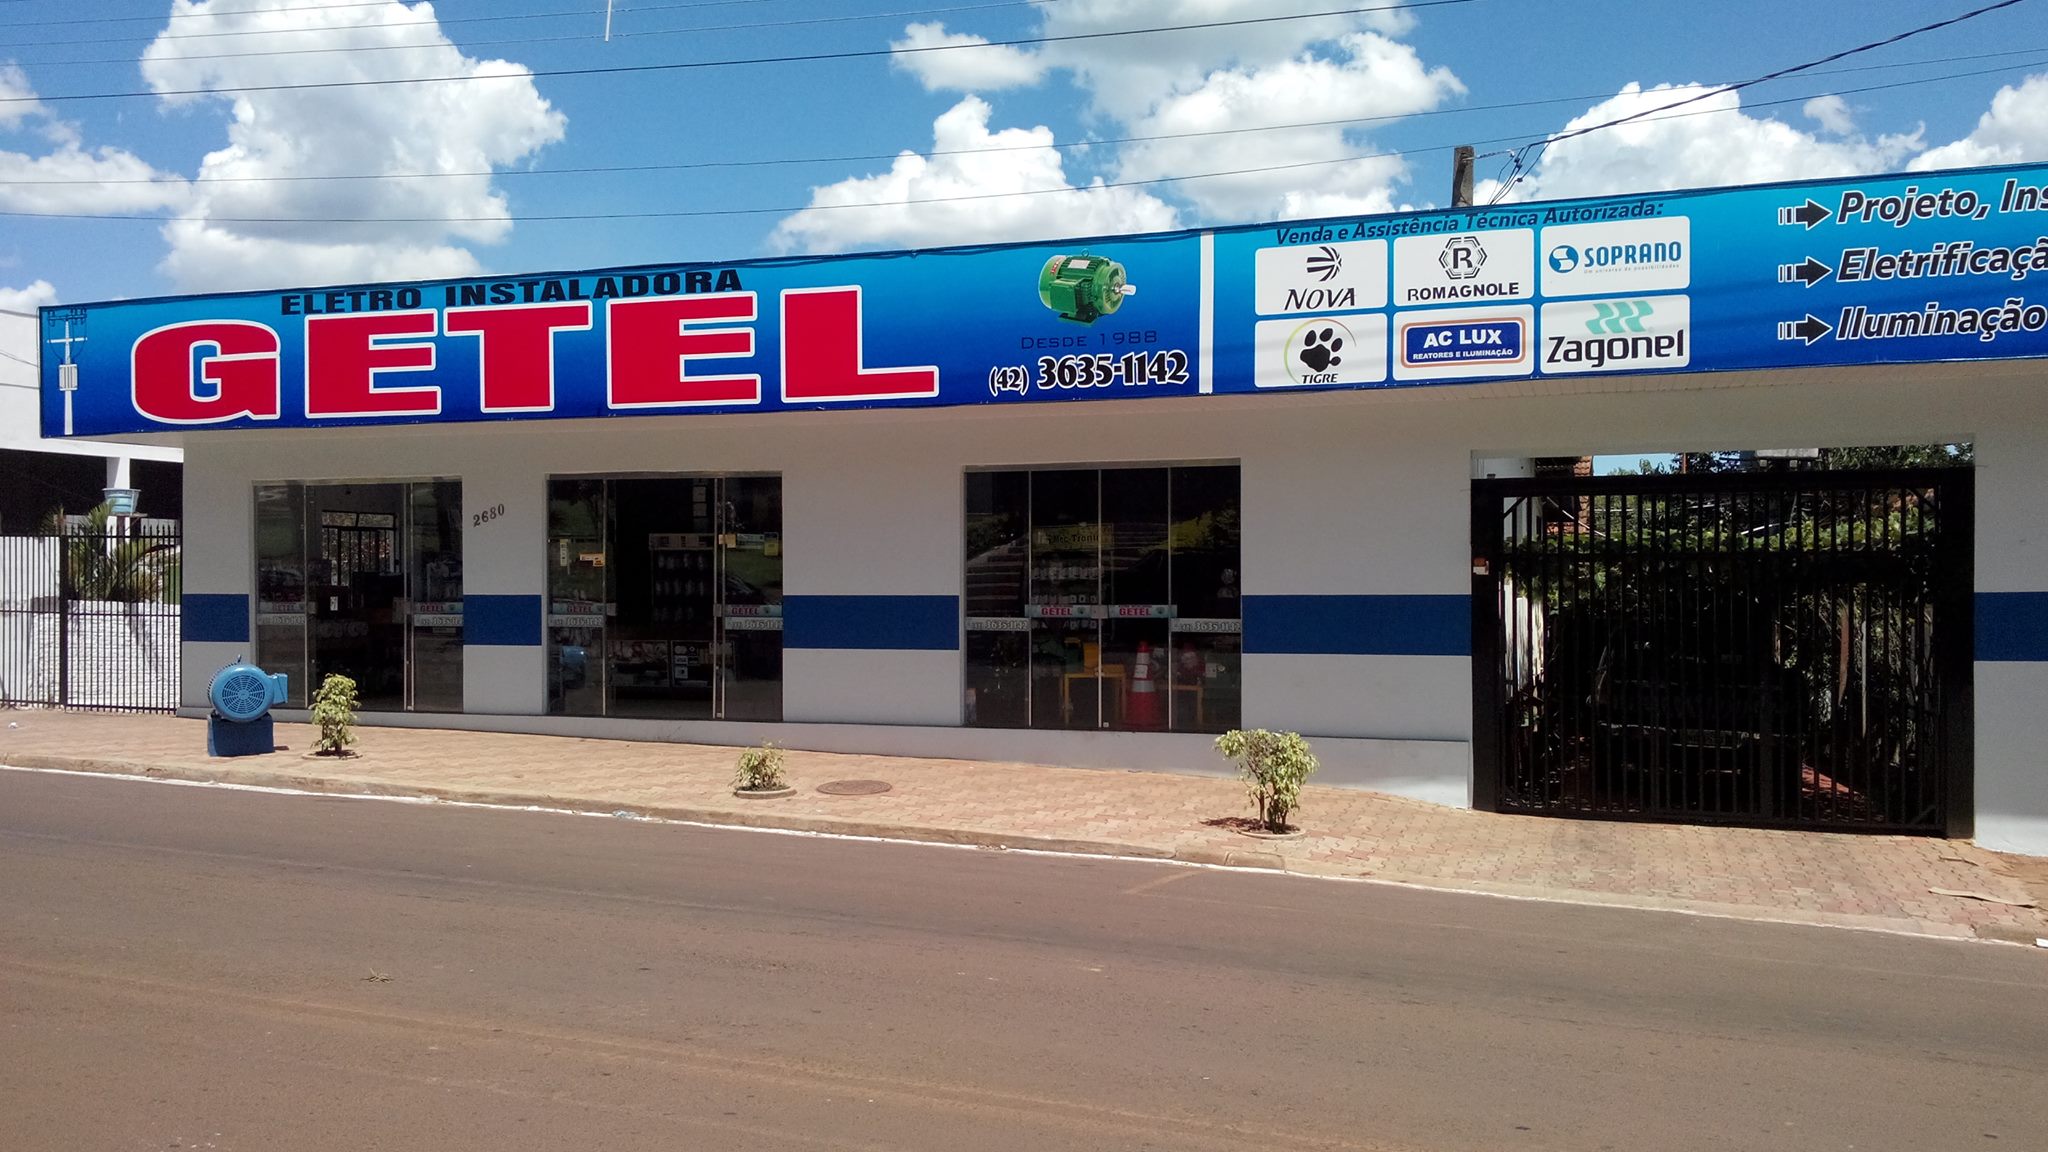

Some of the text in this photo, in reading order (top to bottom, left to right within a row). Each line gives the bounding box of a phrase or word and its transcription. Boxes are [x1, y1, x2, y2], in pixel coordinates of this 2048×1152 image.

[1836, 186, 1991, 228] Projeto,
[1275, 200, 1664, 245] Venda e Assistência Técnica Autorizada:
[1453, 248, 1473, 269] R
[1584, 241, 1682, 267] SOPRANO
[1836, 236, 2048, 282] Eletrificaçã
[281, 268, 743, 315] ELETRO INSTALADORA
[1285, 287, 1356, 311] NOVA
[1407, 282, 1519, 301] ROMAGNOLE
[1836, 297, 2047, 342] Iluminação
[1099, 329, 1158, 347] 1988
[1423, 329, 1502, 348] AC LUX
[1547, 329, 1685, 368] Zagonel
[131, 284, 939, 424] GETEL
[1413, 352, 1454, 360] REATORES
[1462, 347, 1514, 358] ILUMINAÇÃO
[989, 350, 1189, 396] (42) 3635-1142
[1302, 372, 1339, 384] TIGRE
[472, 503, 506, 527] 2680
[566, 605, 593, 613] GETEL
[731, 607, 759, 615] GETEL
[1041, 607, 1073, 616] GETEL
[1119, 607, 1152, 616] GETEL
